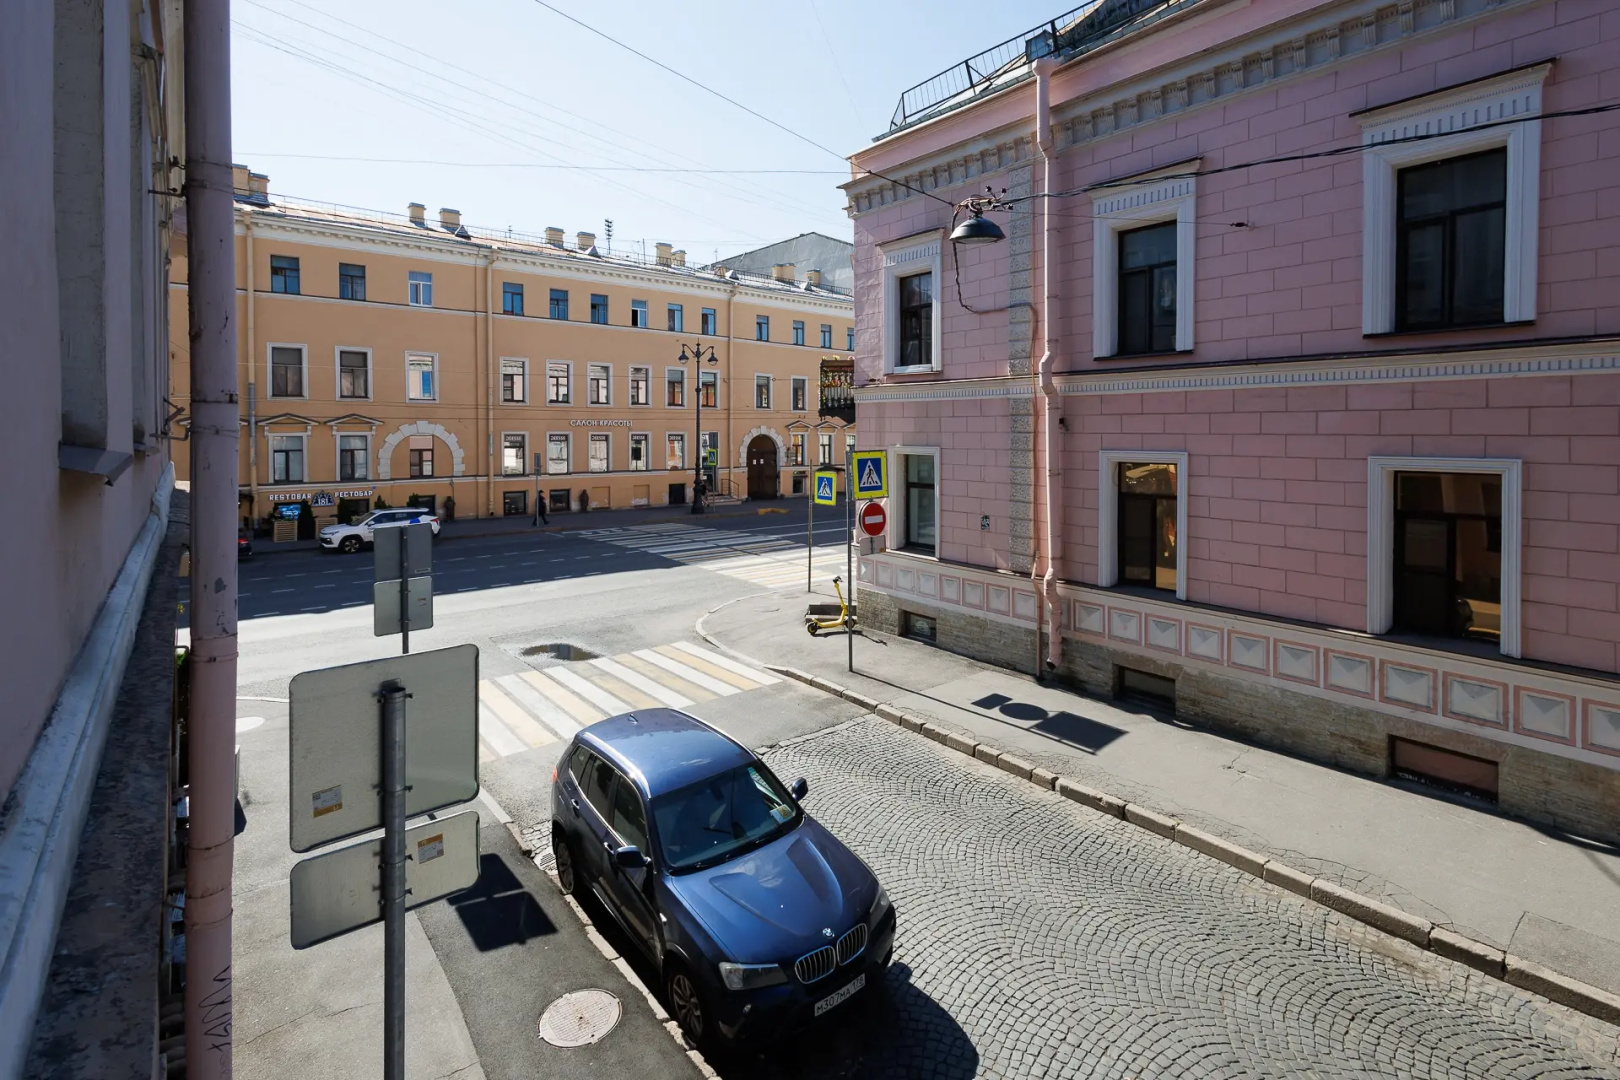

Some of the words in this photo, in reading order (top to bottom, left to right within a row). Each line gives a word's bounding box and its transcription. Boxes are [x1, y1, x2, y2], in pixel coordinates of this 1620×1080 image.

[570, 419, 597, 427] САЛОН
[599, 419, 633, 427] КРАСОТЫ
[269, 493, 312, 501] RESTOBAR
[334, 490, 373, 498] РЕСТОБАР
